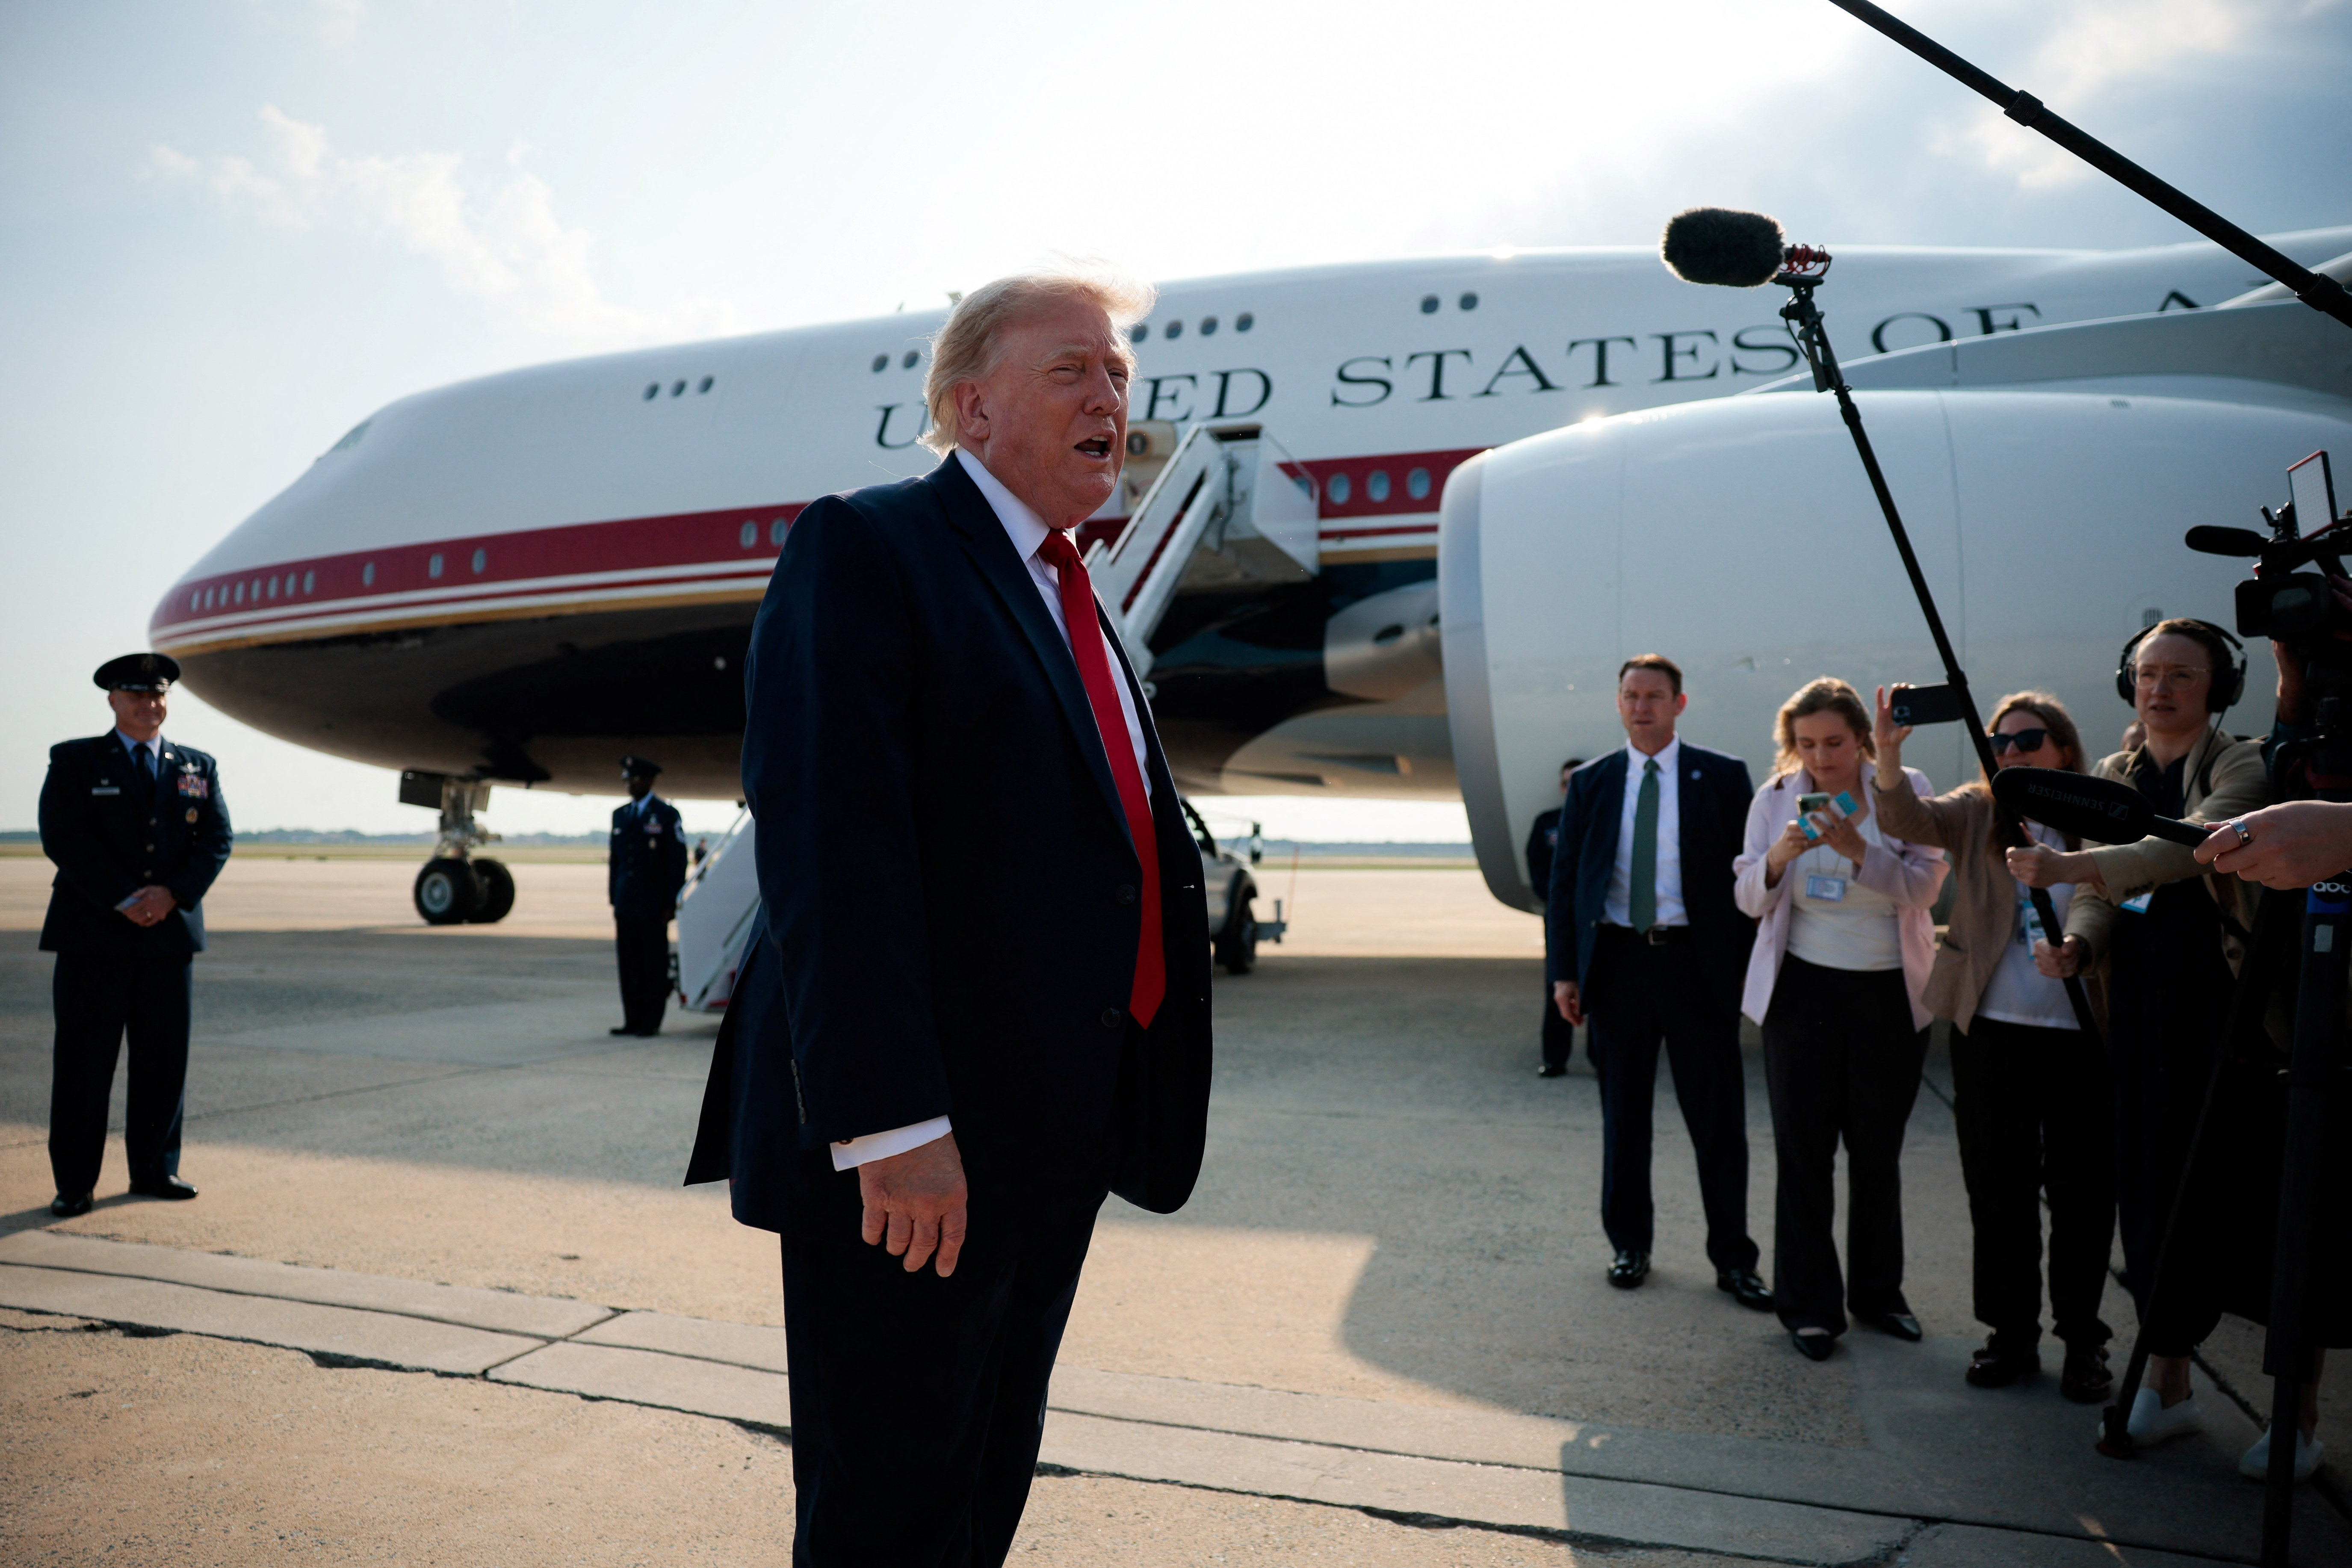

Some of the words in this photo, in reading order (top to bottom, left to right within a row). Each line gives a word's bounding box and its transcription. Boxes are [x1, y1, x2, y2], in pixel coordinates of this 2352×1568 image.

[875, 368, 1273, 450] UED
[1330, 324, 1799, 408] STATES
[1871, 302, 2042, 354] OF
[2027, 783, 2105, 811] SENNHEISER
[2313, 881, 2351, 894] abc
